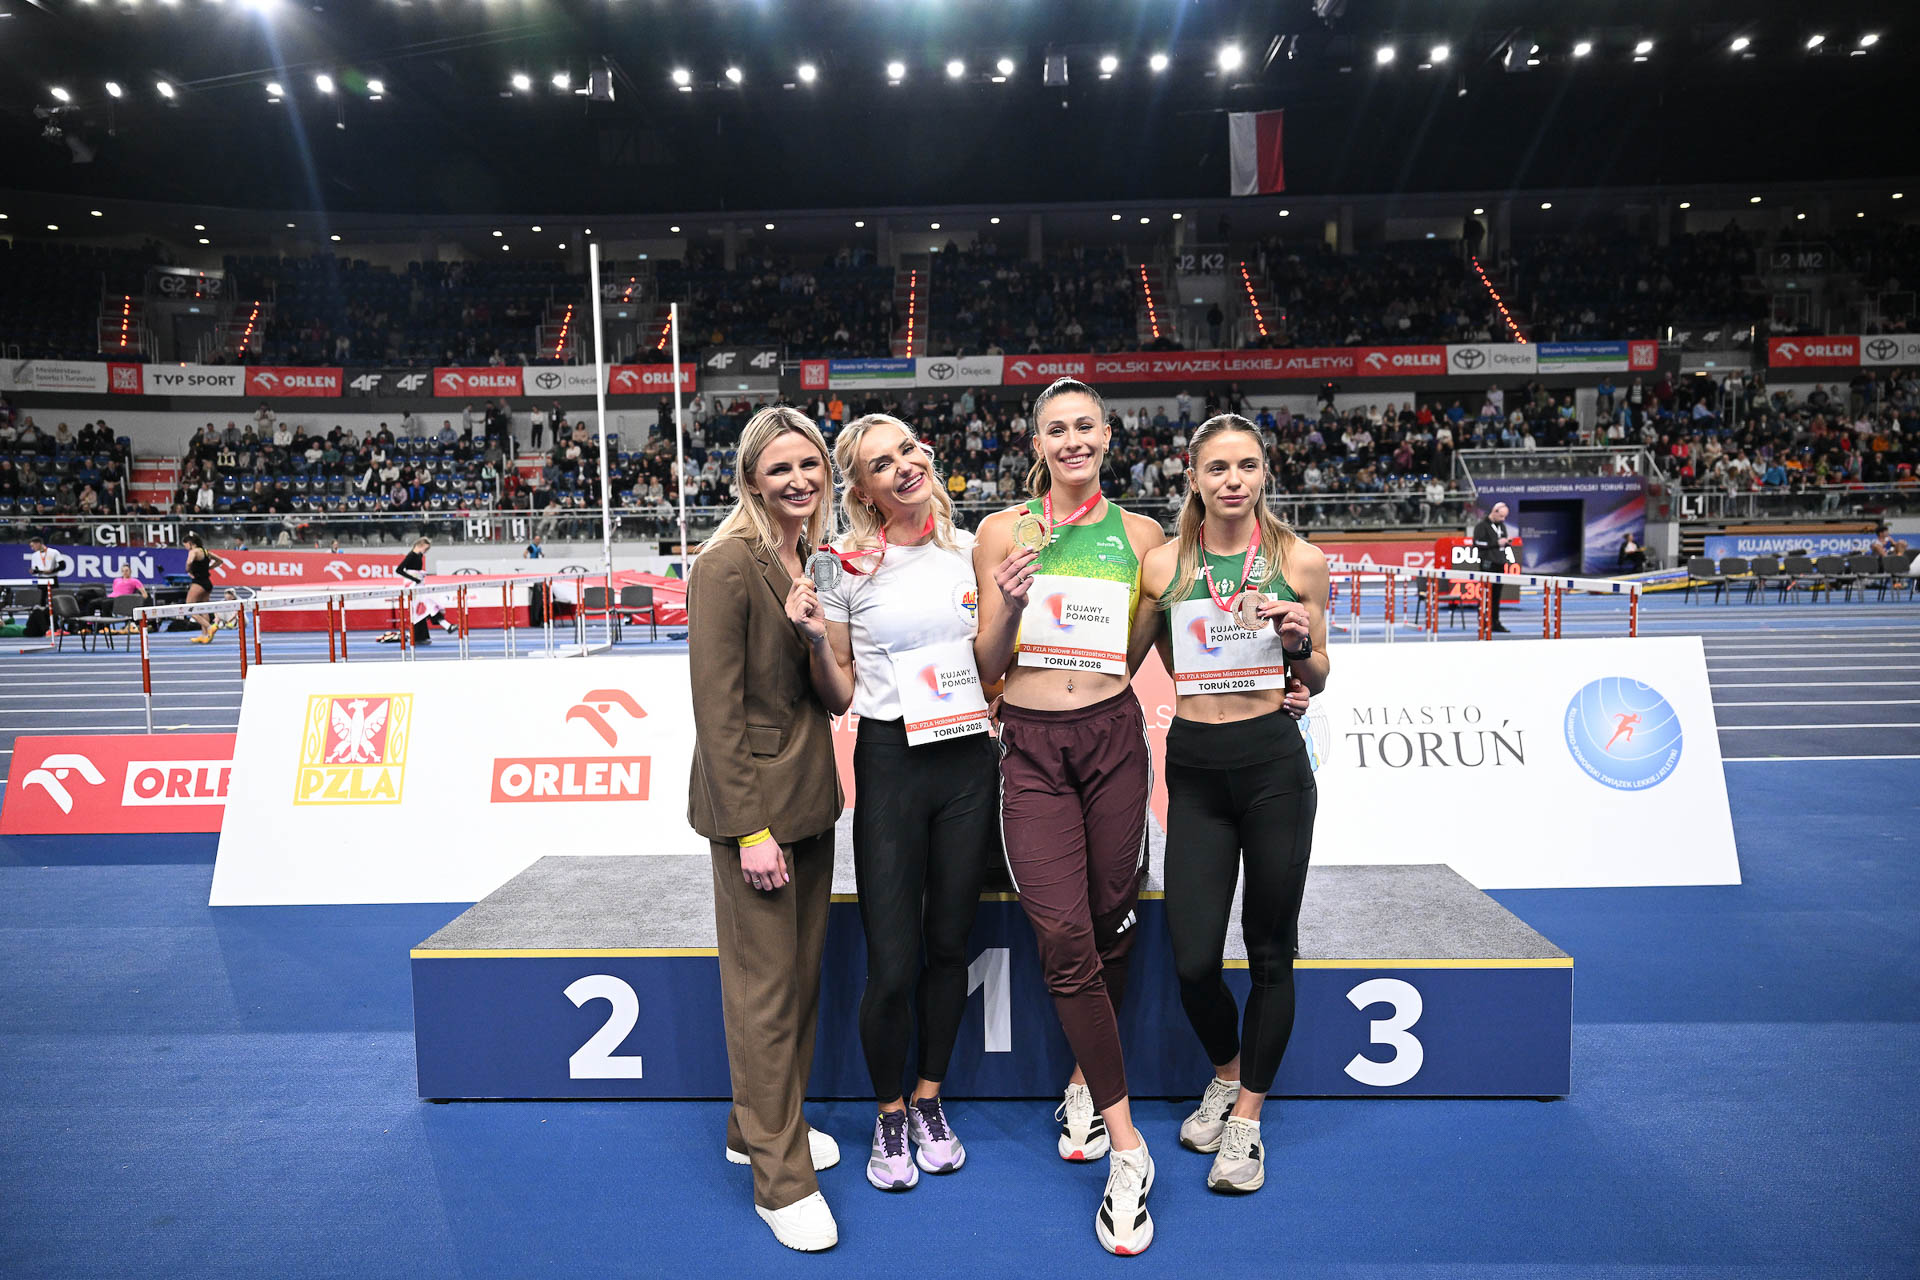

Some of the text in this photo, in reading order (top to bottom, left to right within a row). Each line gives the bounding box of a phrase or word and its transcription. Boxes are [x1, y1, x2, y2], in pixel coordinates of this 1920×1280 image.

[1176, 254, 1224, 270] J2 K2
[160, 276, 222, 294] G2 H2
[1804, 344, 1854, 357] ORLEN
[707, 352, 736, 369] 4F
[750, 352, 777, 368] 4F
[1096, 356, 1354, 374] POLSKI ZWIĄZEK LEKKIEJ ATLETYKI
[1392, 354, 1441, 367] ORLEN
[1037, 362, 1084, 375] ORLEN
[153, 374, 236, 387] TVP SPORT
[283, 374, 336, 388] ORLEN
[350, 374, 382, 391] 4F
[396, 374, 427, 391] 4F
[468, 374, 517, 388] ORLEN
[1615, 454, 1640, 473] K1
[1681, 496, 1704, 514] L1
[95, 524, 127, 544] G1
[148, 524, 174, 543] H1
[467, 518, 490, 538] H1
[1738, 538, 1876, 553] KUJAWSKO-POMOR
[23, 550, 154, 579] ORUŃ
[241, 562, 304, 577] ORLEN
[1066, 604, 1103, 614] KUJAWY
[1066, 612, 1110, 624] POMORZE
[1210, 624, 1246, 634] KUJAW
[1211, 631, 1258, 642] POMORZE
[1048, 647, 1070, 655] Halowe
[1071, 649, 1106, 658] Mistrzostwa
[1044, 657, 1102, 669] TORUŃ 2026
[940, 668, 971, 680] KUJAWY
[942, 676, 977, 689] POMORZE
[1198, 680, 1256, 690] TORUŃ 2026
[1352, 704, 1482, 726] MIASTO
[933, 724, 965, 738] TORUŃ
[1345, 719, 1525, 768] TORUŃ
[133, 767, 232, 799] ORLE
[300, 768, 396, 799] PZLA
[500, 762, 641, 797] ORLEN
[967, 948, 1012, 1052] 1
[562, 974, 643, 1079] 2
[1343, 978, 1424, 1087] 3
